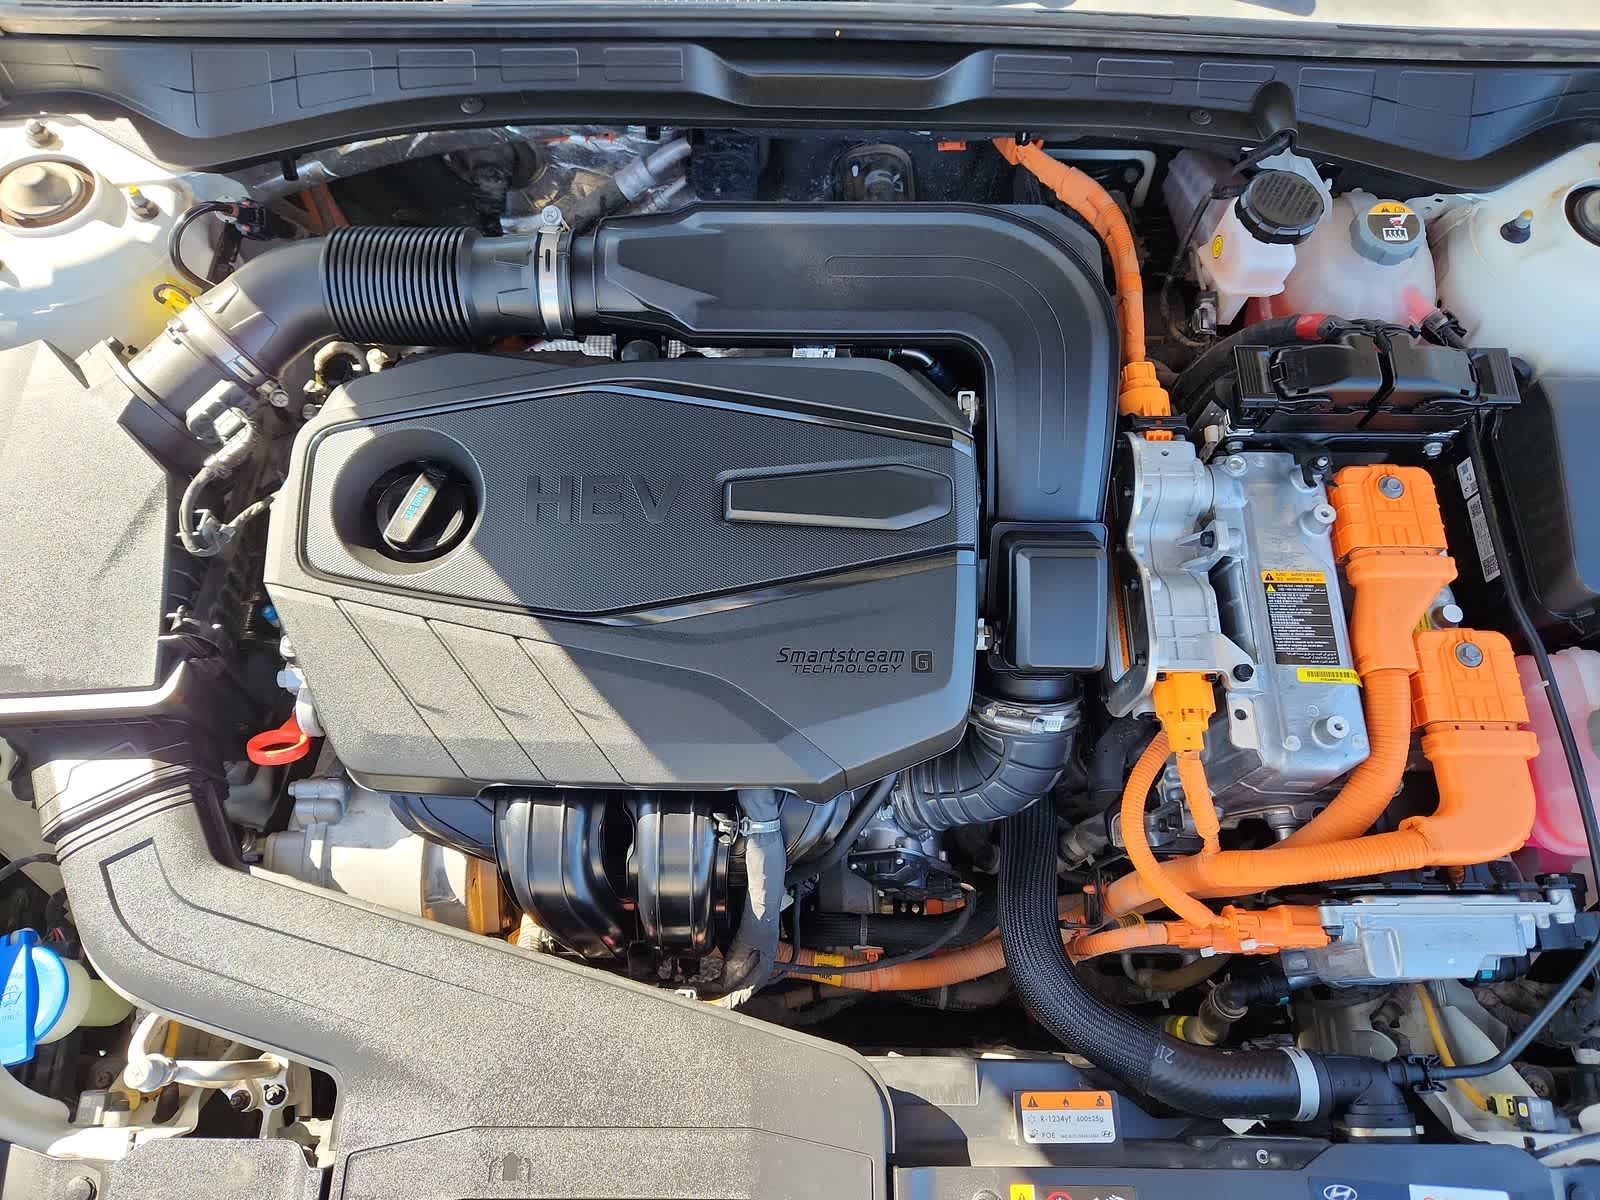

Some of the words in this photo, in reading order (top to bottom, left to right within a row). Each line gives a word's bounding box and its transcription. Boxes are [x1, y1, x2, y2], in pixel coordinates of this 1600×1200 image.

[525, 474, 682, 523] HEV
[776, 647, 905, 663] Smartstream
[792, 664, 901, 674] TECHNOLOGY
